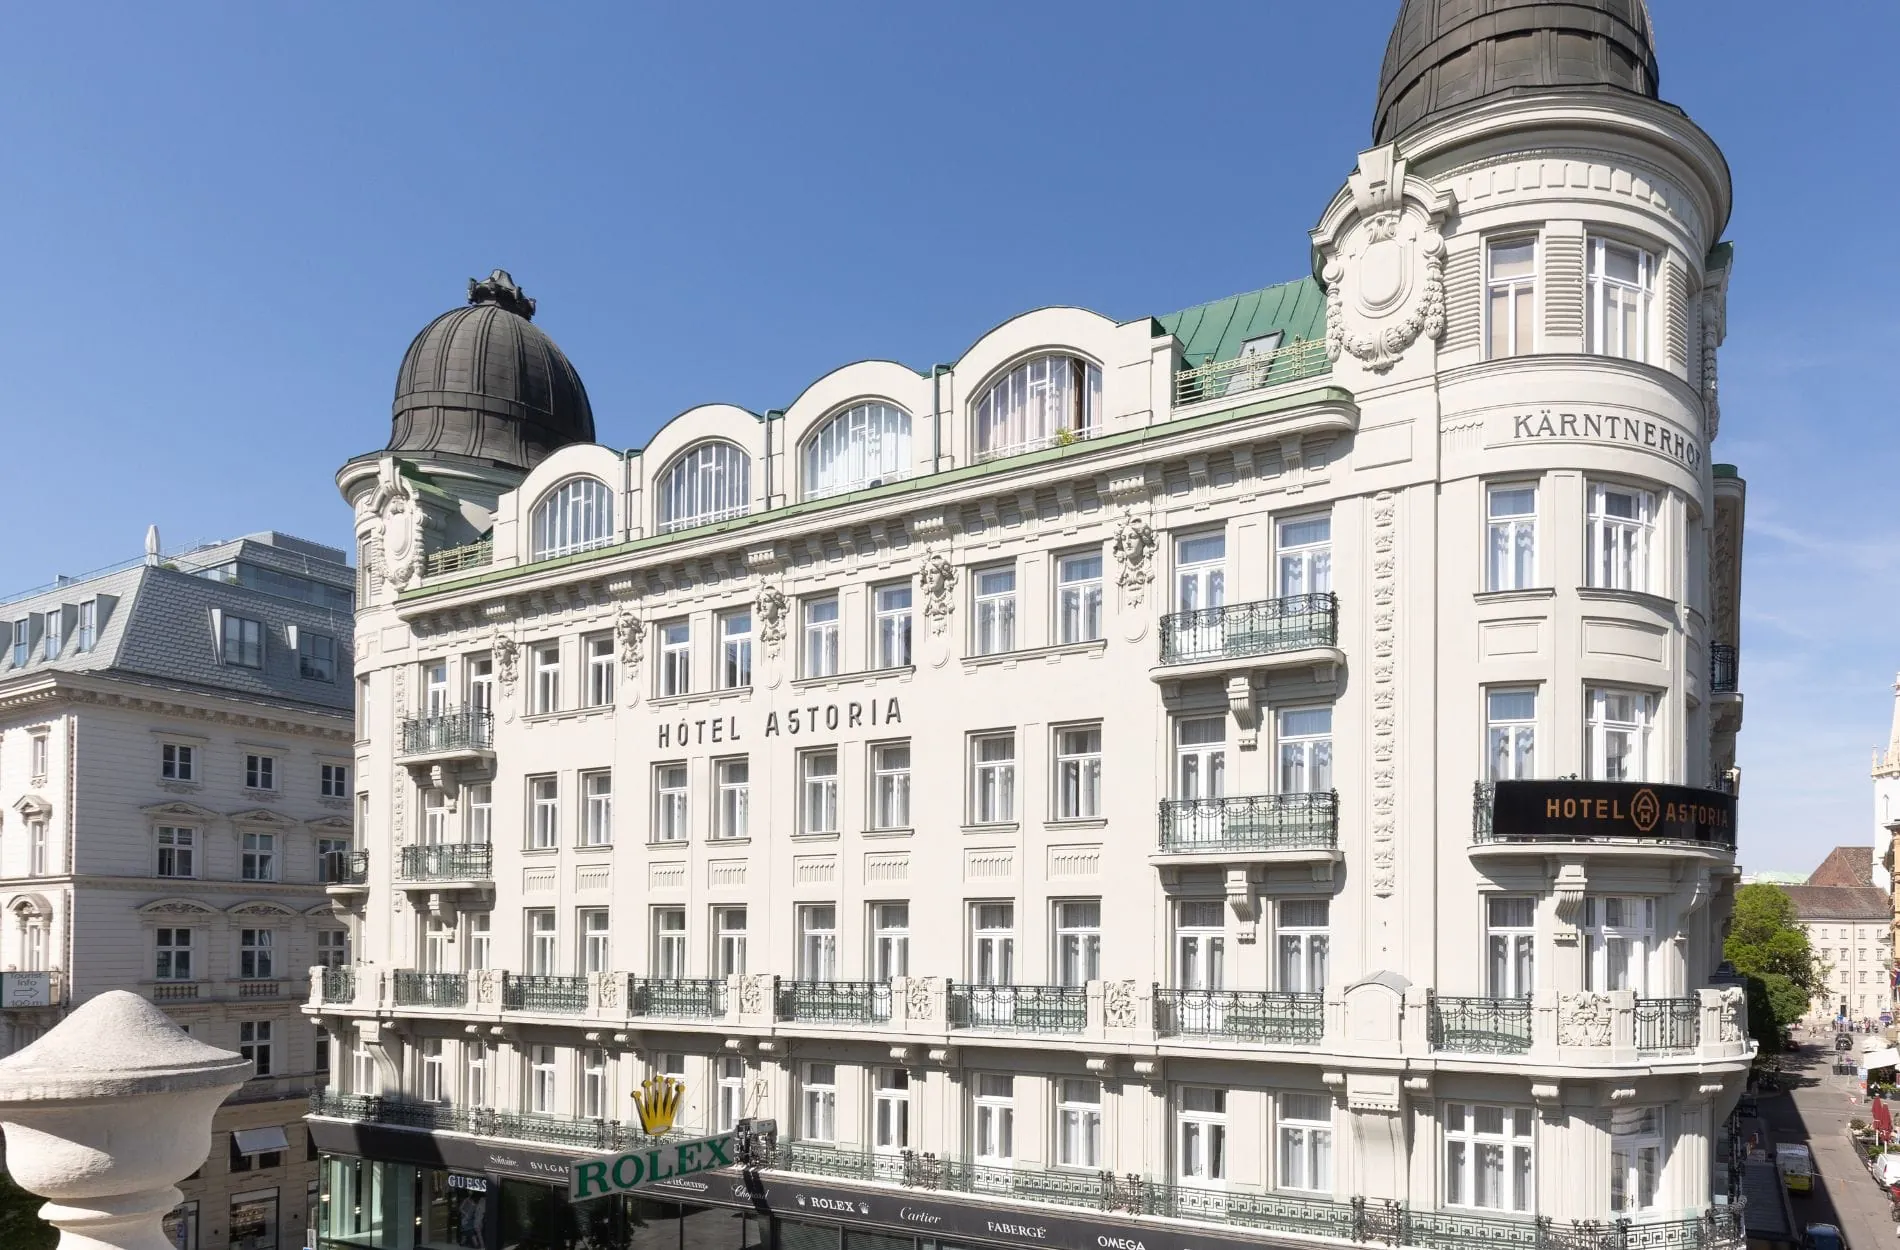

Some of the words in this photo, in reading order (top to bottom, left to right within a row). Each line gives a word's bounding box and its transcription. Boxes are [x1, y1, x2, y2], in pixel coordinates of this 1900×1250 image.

[765, 696, 902, 737] ASTORIA
[1546, 798, 1625, 819] HOTEL
[1665, 802, 1729, 829] ASTORIA
[574, 1136, 734, 1199] ROLEX
[447, 1174, 487, 1192] GUESS
[810, 1196, 856, 1213] ROLEX
[900, 1206, 942, 1224] Cartier
[987, 1221, 1046, 1239] FABERGÉ
[1097, 1235, 1146, 1250] OMEGA
